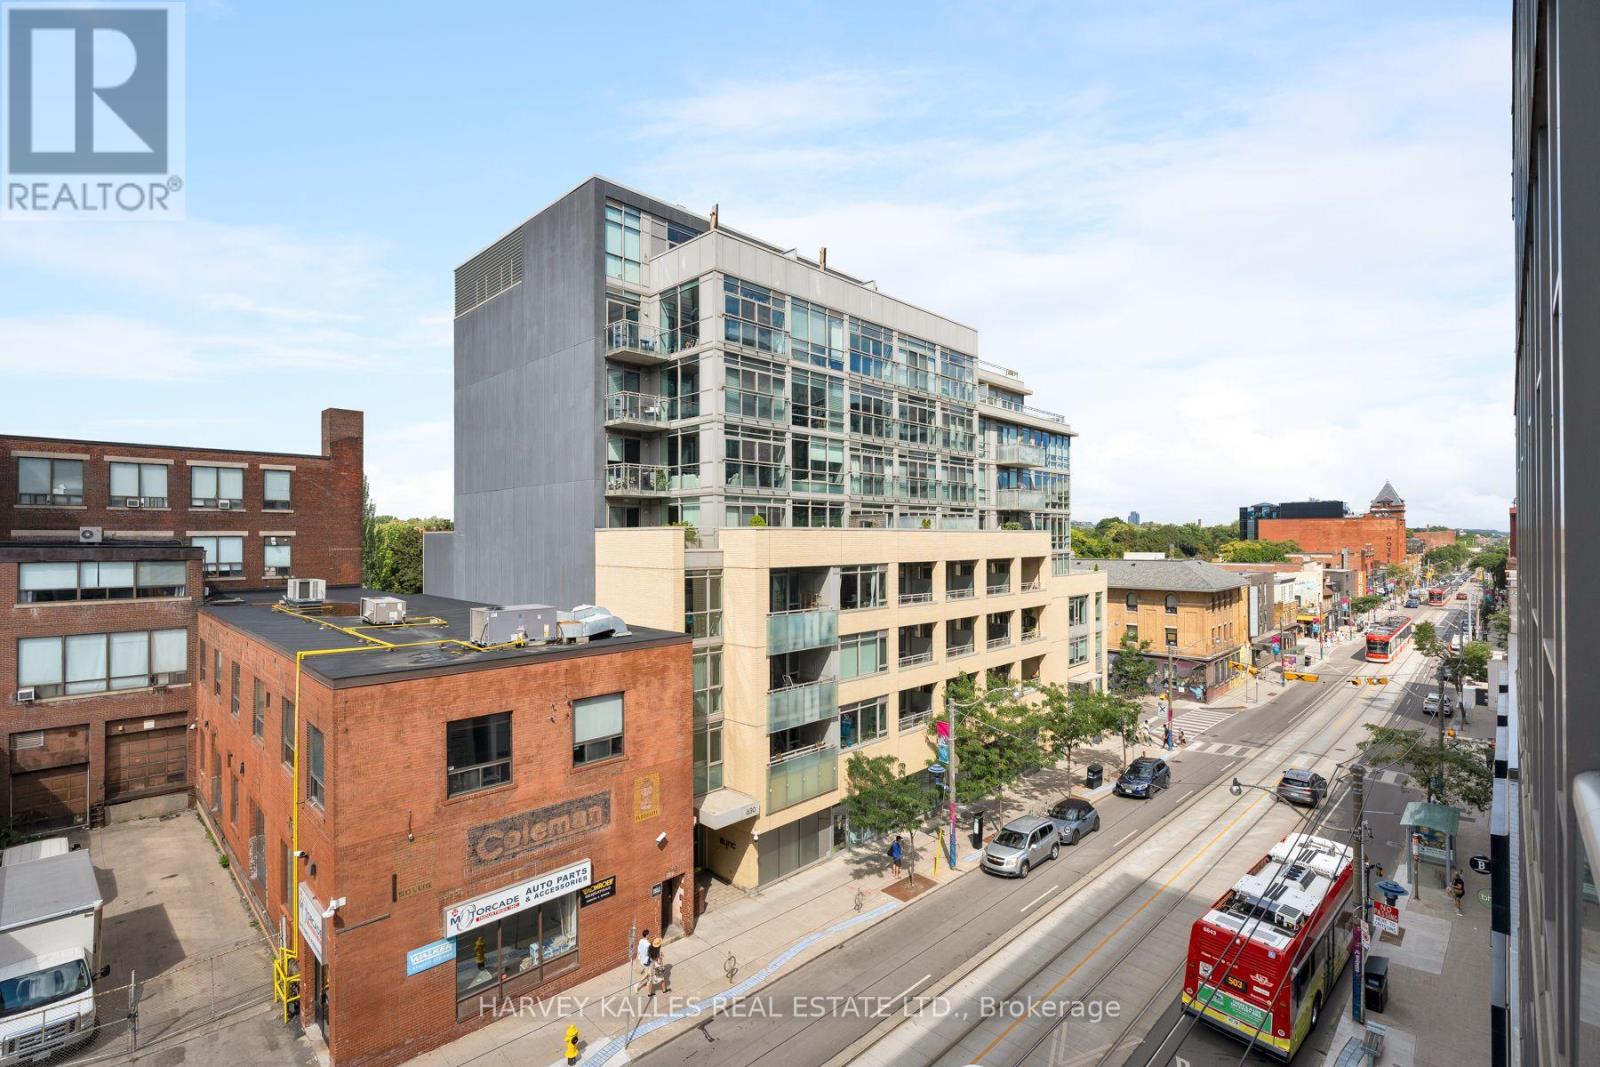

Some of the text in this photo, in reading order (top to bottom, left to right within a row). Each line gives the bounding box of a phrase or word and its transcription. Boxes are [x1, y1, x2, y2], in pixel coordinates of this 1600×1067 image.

[474, 804, 603, 861] Coleman
[1478, 860, 1486, 870] B
[525, 867, 588, 896] AUTO PARTS
[525, 895, 531, 903] &
[534, 875, 588, 900] ACCESSORIES
[450, 894, 520, 932] MOTORCADE
[1380, 904, 1392, 913] NO
[1228, 976, 1243, 989] 503
